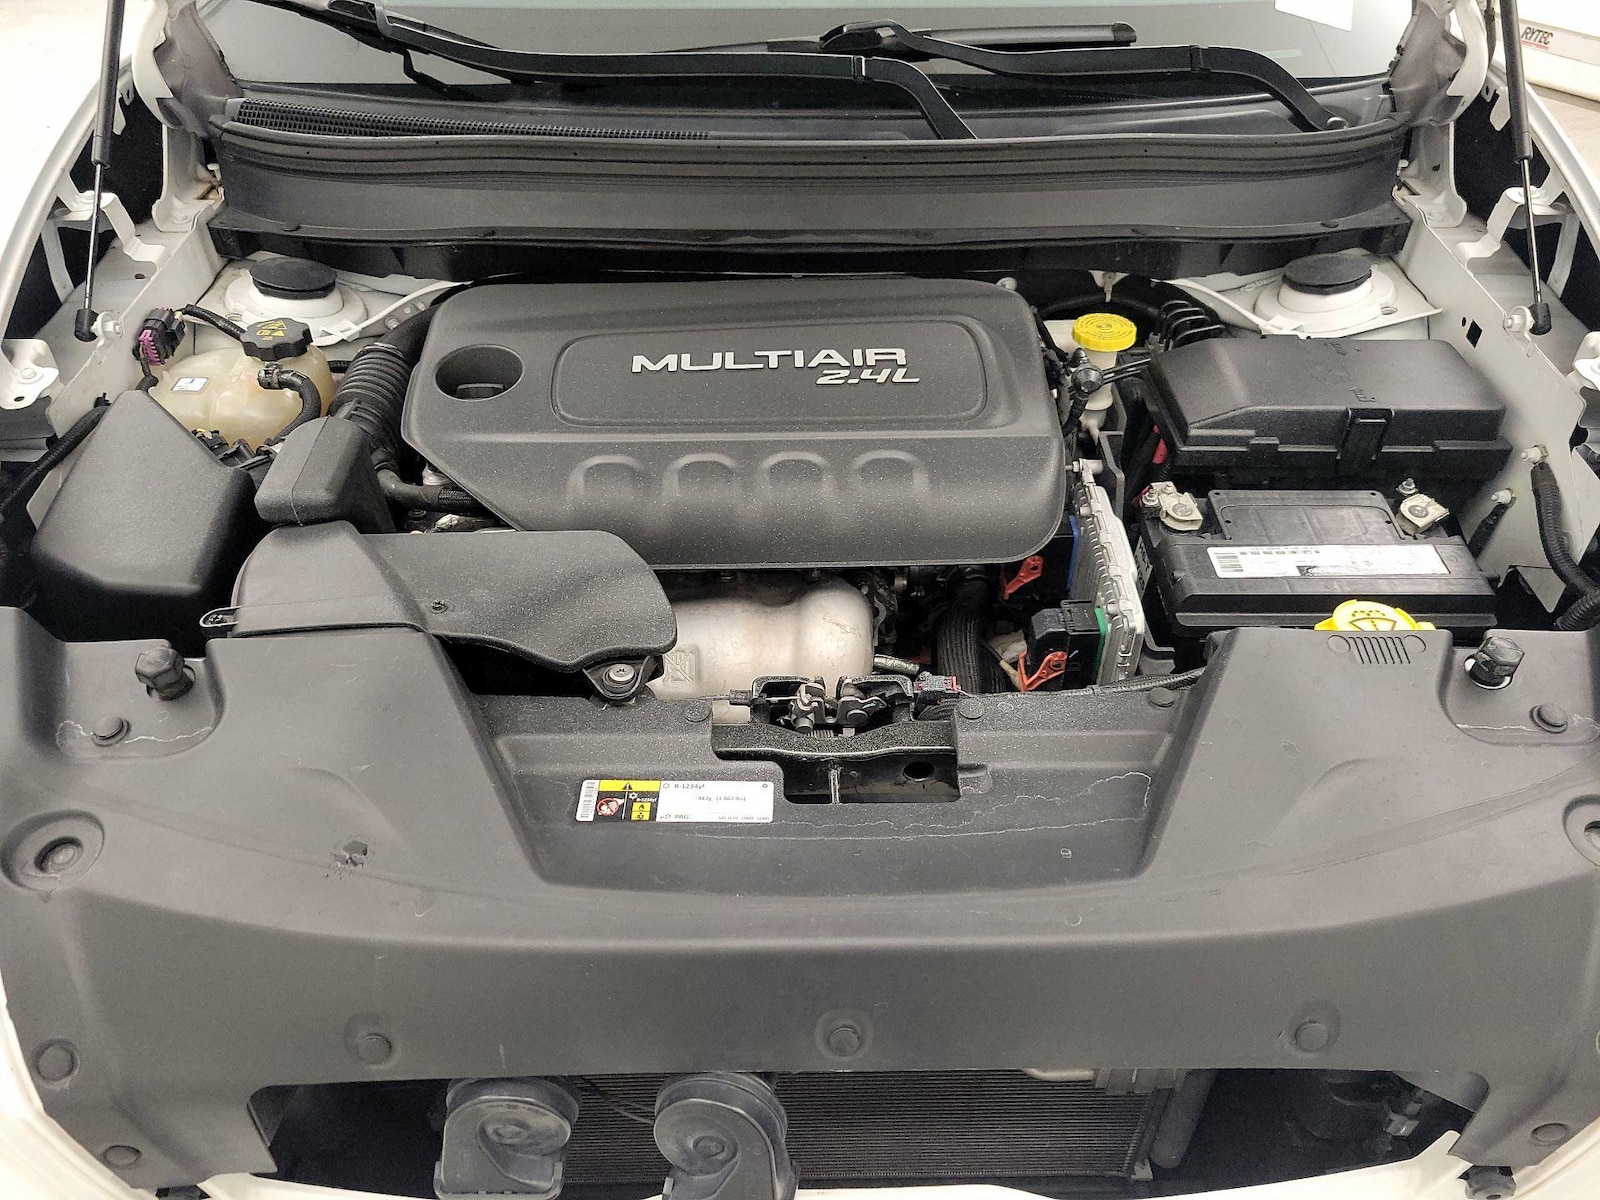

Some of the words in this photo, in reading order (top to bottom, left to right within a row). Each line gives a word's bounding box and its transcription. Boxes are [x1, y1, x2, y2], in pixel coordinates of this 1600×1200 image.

[1520, 26, 1554, 45] RYTEC
[631, 348, 907, 373] MULTIAIR
[815, 367, 921, 386] 2.4L
